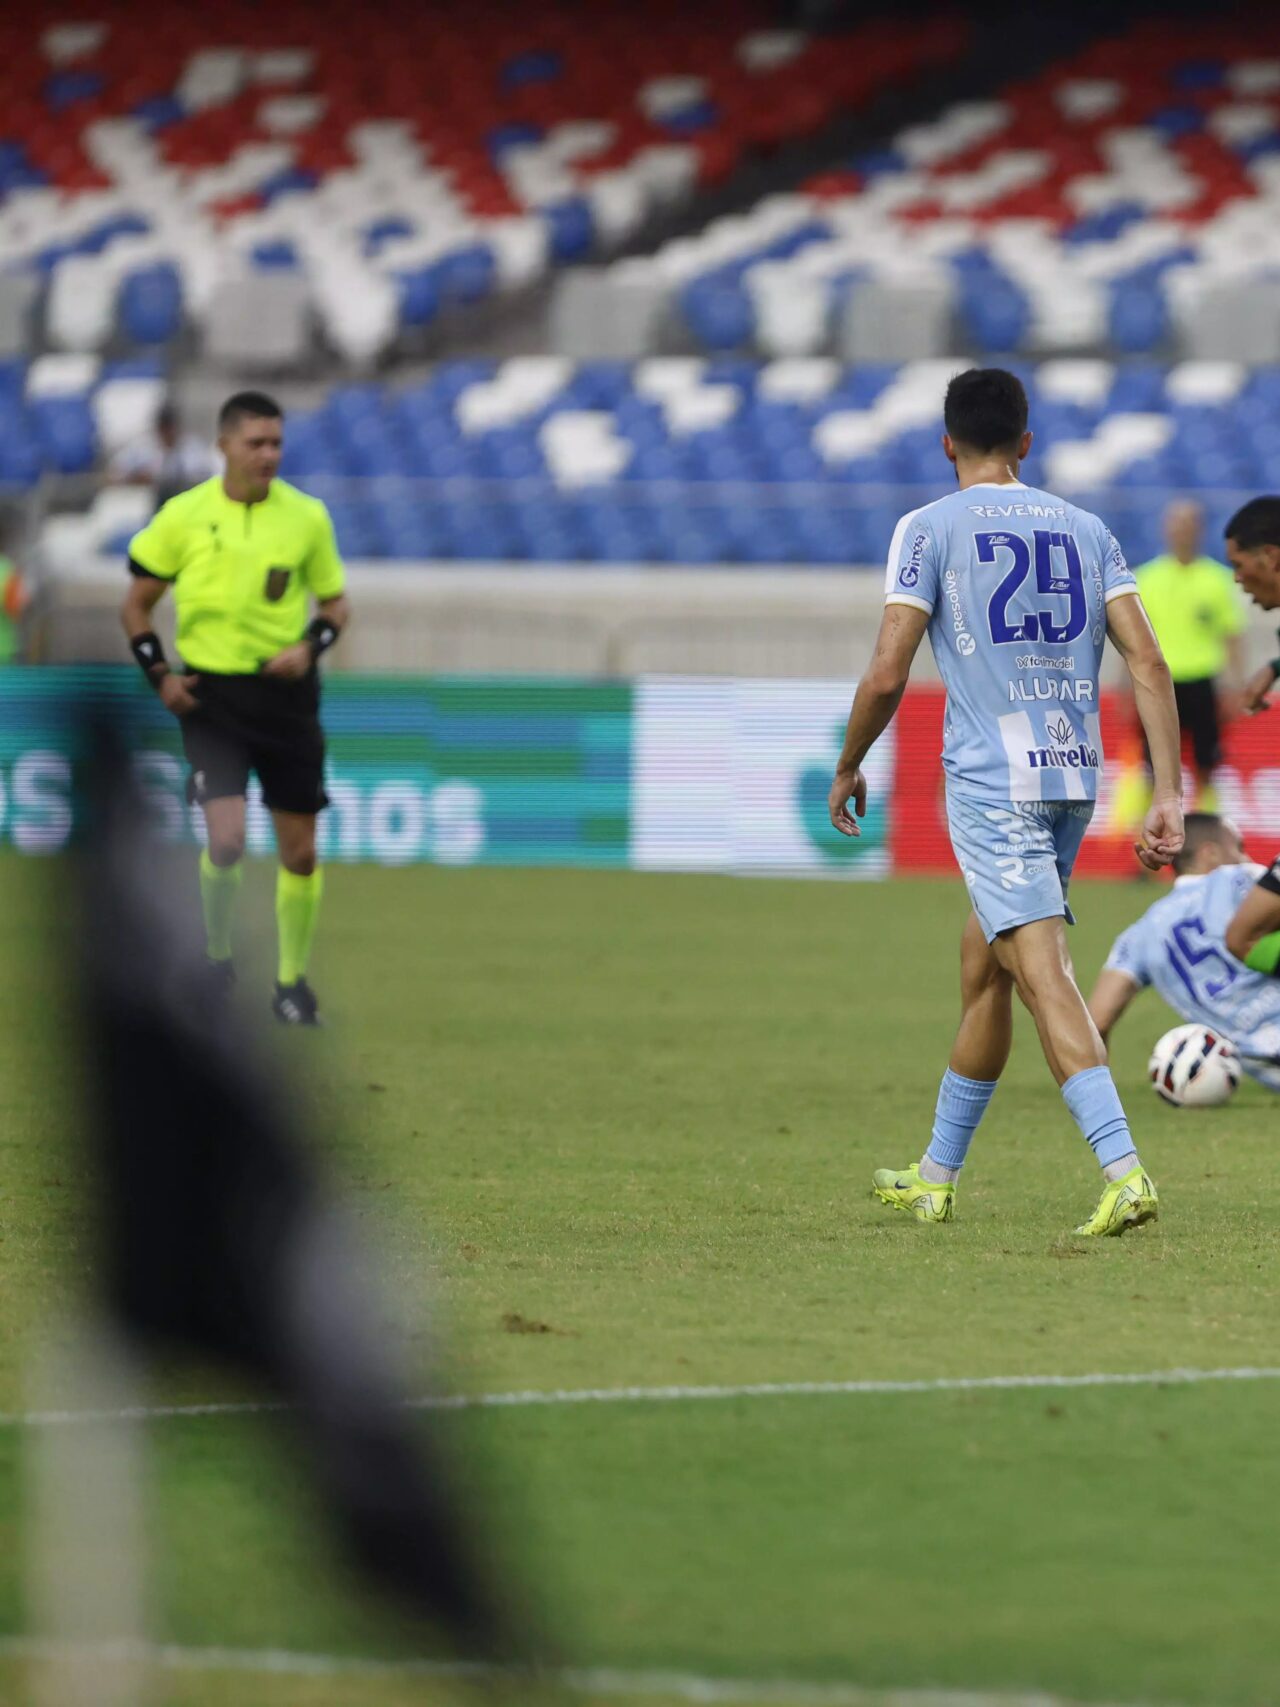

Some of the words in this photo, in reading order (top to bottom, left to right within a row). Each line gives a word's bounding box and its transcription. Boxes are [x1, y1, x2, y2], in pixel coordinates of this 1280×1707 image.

[968, 504, 1065, 519] REVEMAR
[946, 569, 966, 632] Resolve
[972, 529, 1088, 645] 29
[1027, 744, 1098, 768] mirella
[1164, 916, 1237, 1003] 15
